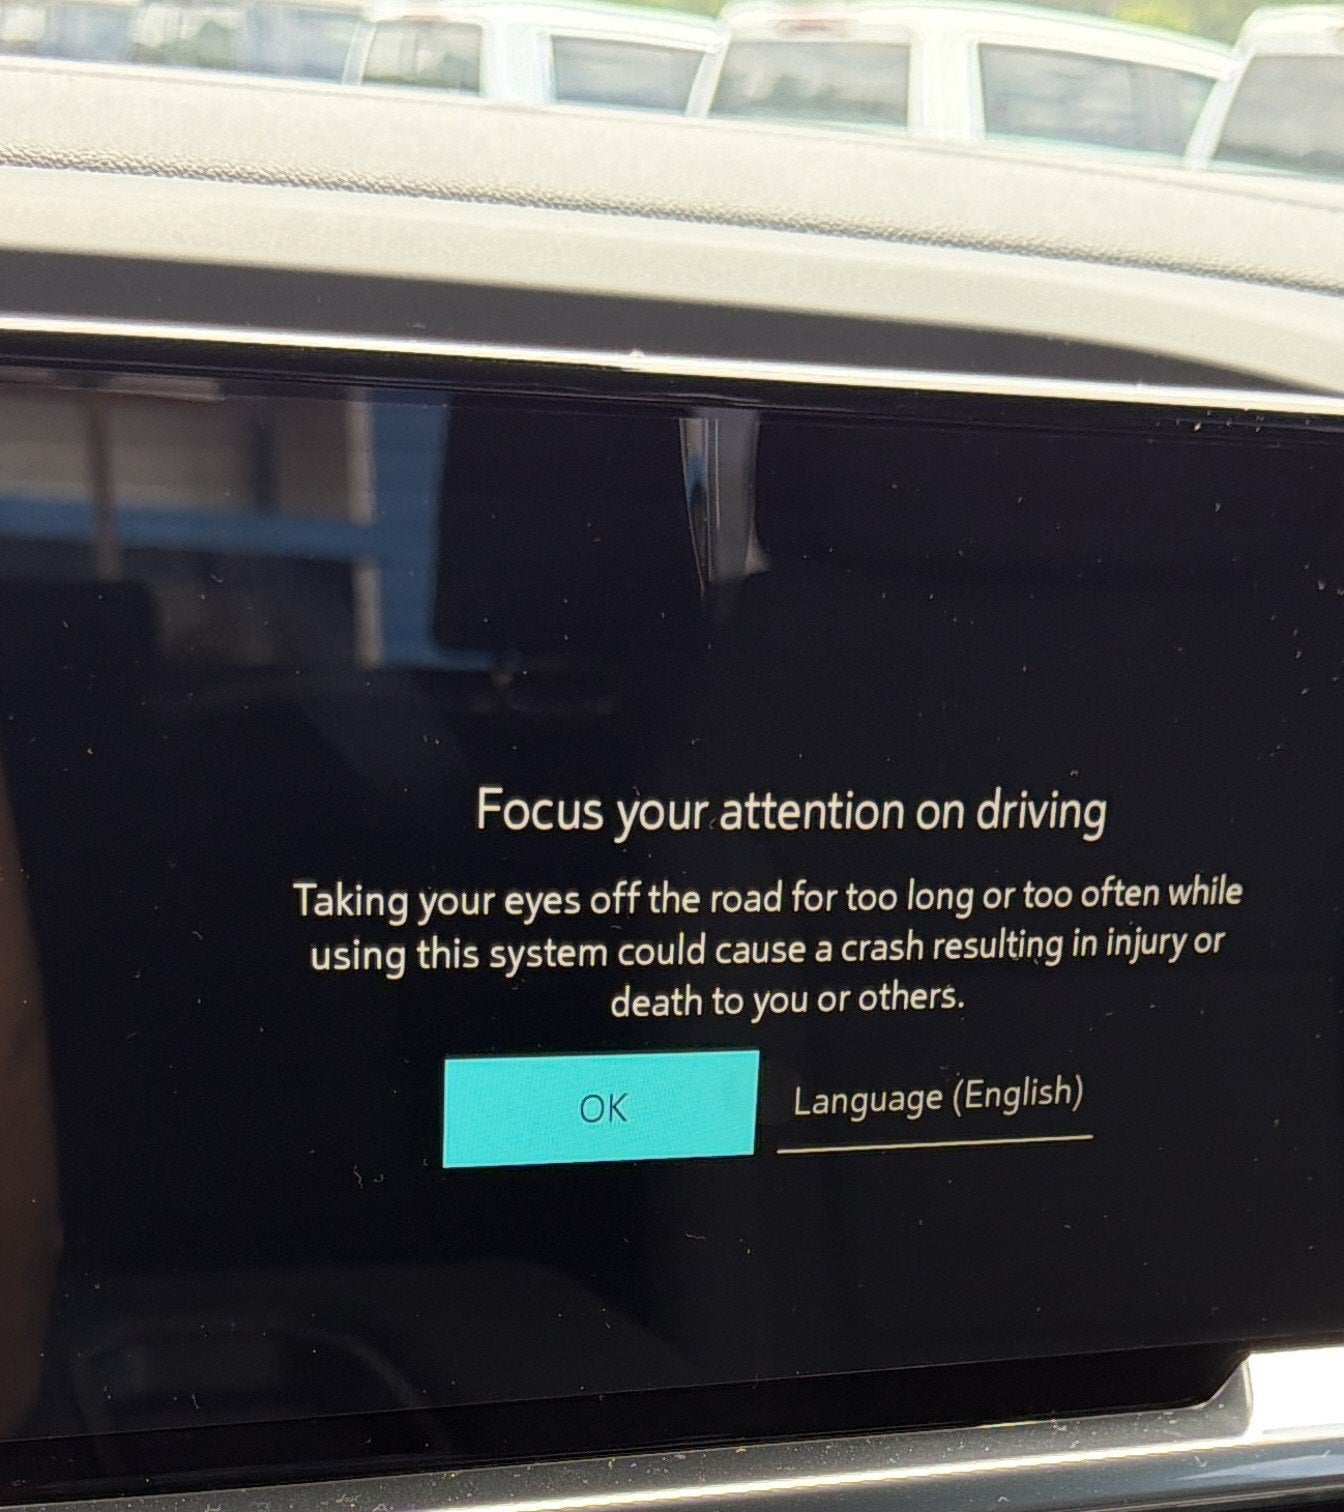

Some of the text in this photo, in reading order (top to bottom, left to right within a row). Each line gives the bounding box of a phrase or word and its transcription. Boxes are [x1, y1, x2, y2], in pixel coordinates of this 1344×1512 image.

[477, 786, 1107, 844] Focus your attention on driving
[293, 873, 1244, 927] Taking your eyes off the road for too long or too often while
[311, 926, 1226, 979] using this system could cause a crash resulting in injury or
[611, 978, 965, 1024] death to you or others.
[580, 1094, 628, 1124] OK
[794, 1074, 1084, 1122] Language (English)
